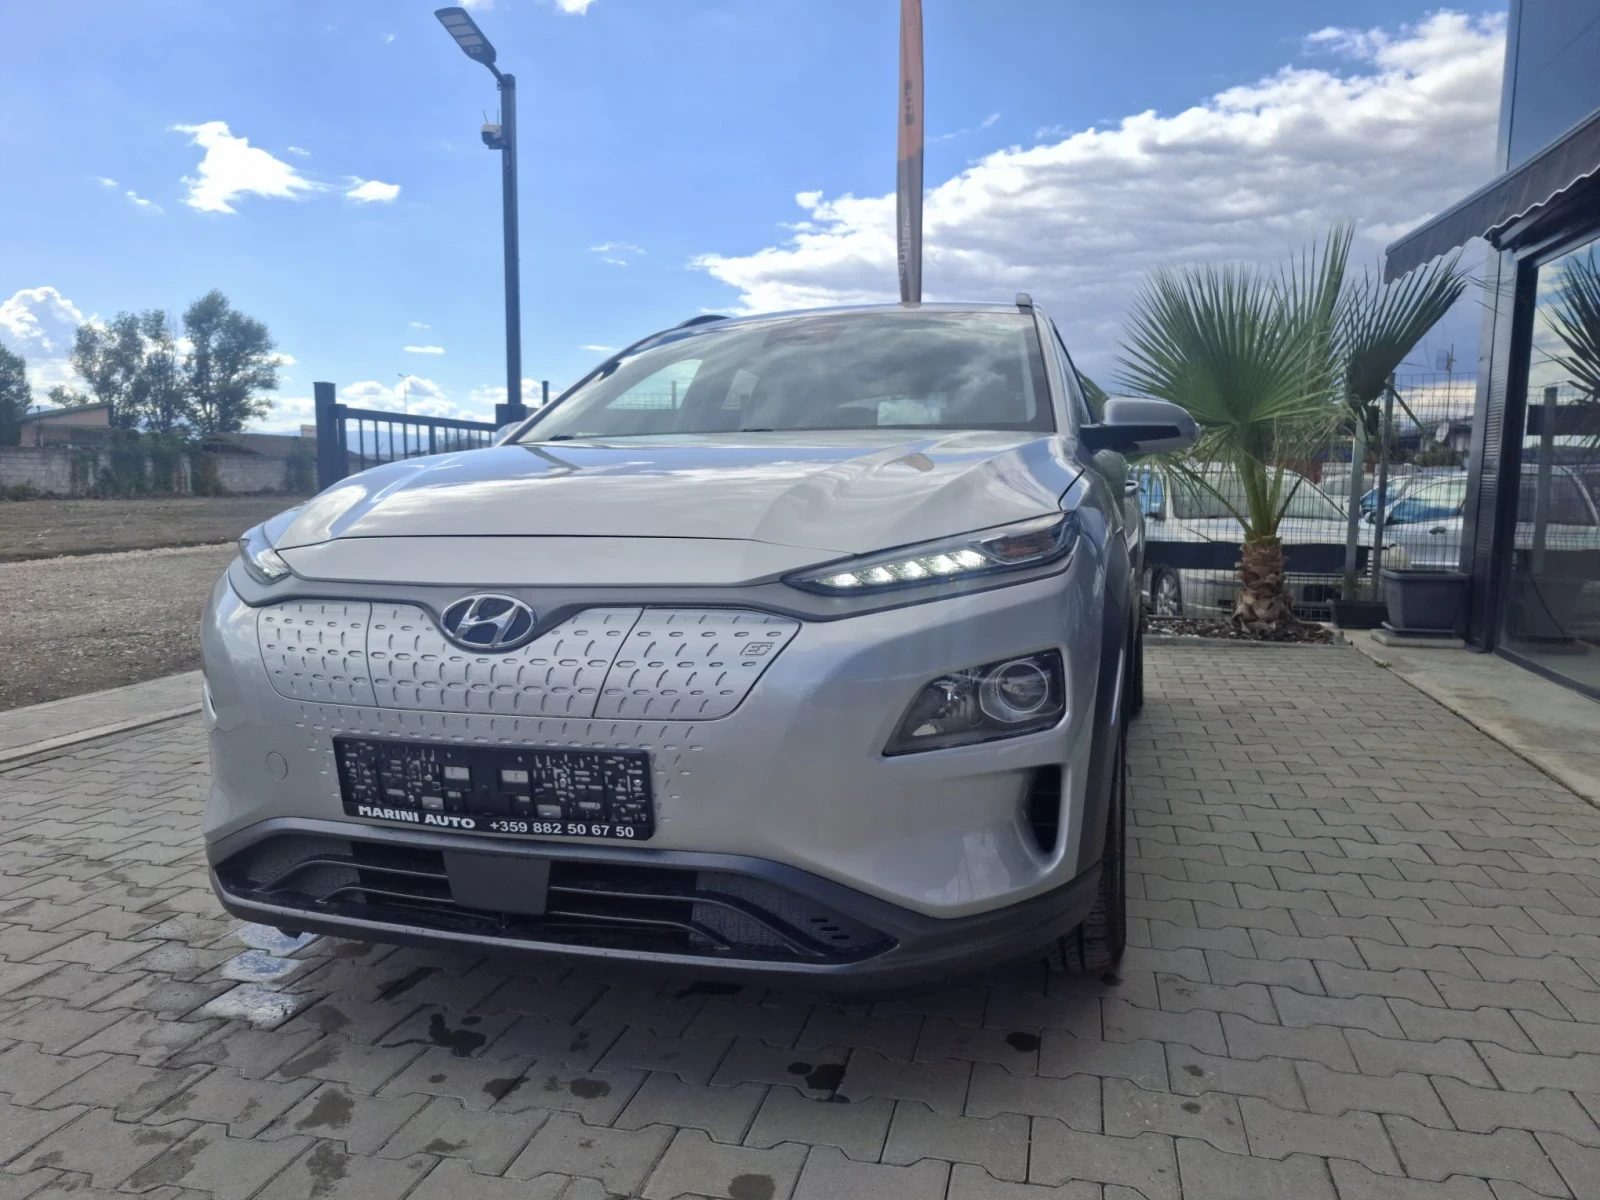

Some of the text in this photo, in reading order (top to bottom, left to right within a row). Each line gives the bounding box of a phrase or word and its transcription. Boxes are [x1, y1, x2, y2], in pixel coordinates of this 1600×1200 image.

[358, 805, 476, 829] MARINI AUTO
[490, 821, 634, 838] +359 882 50 67 50
